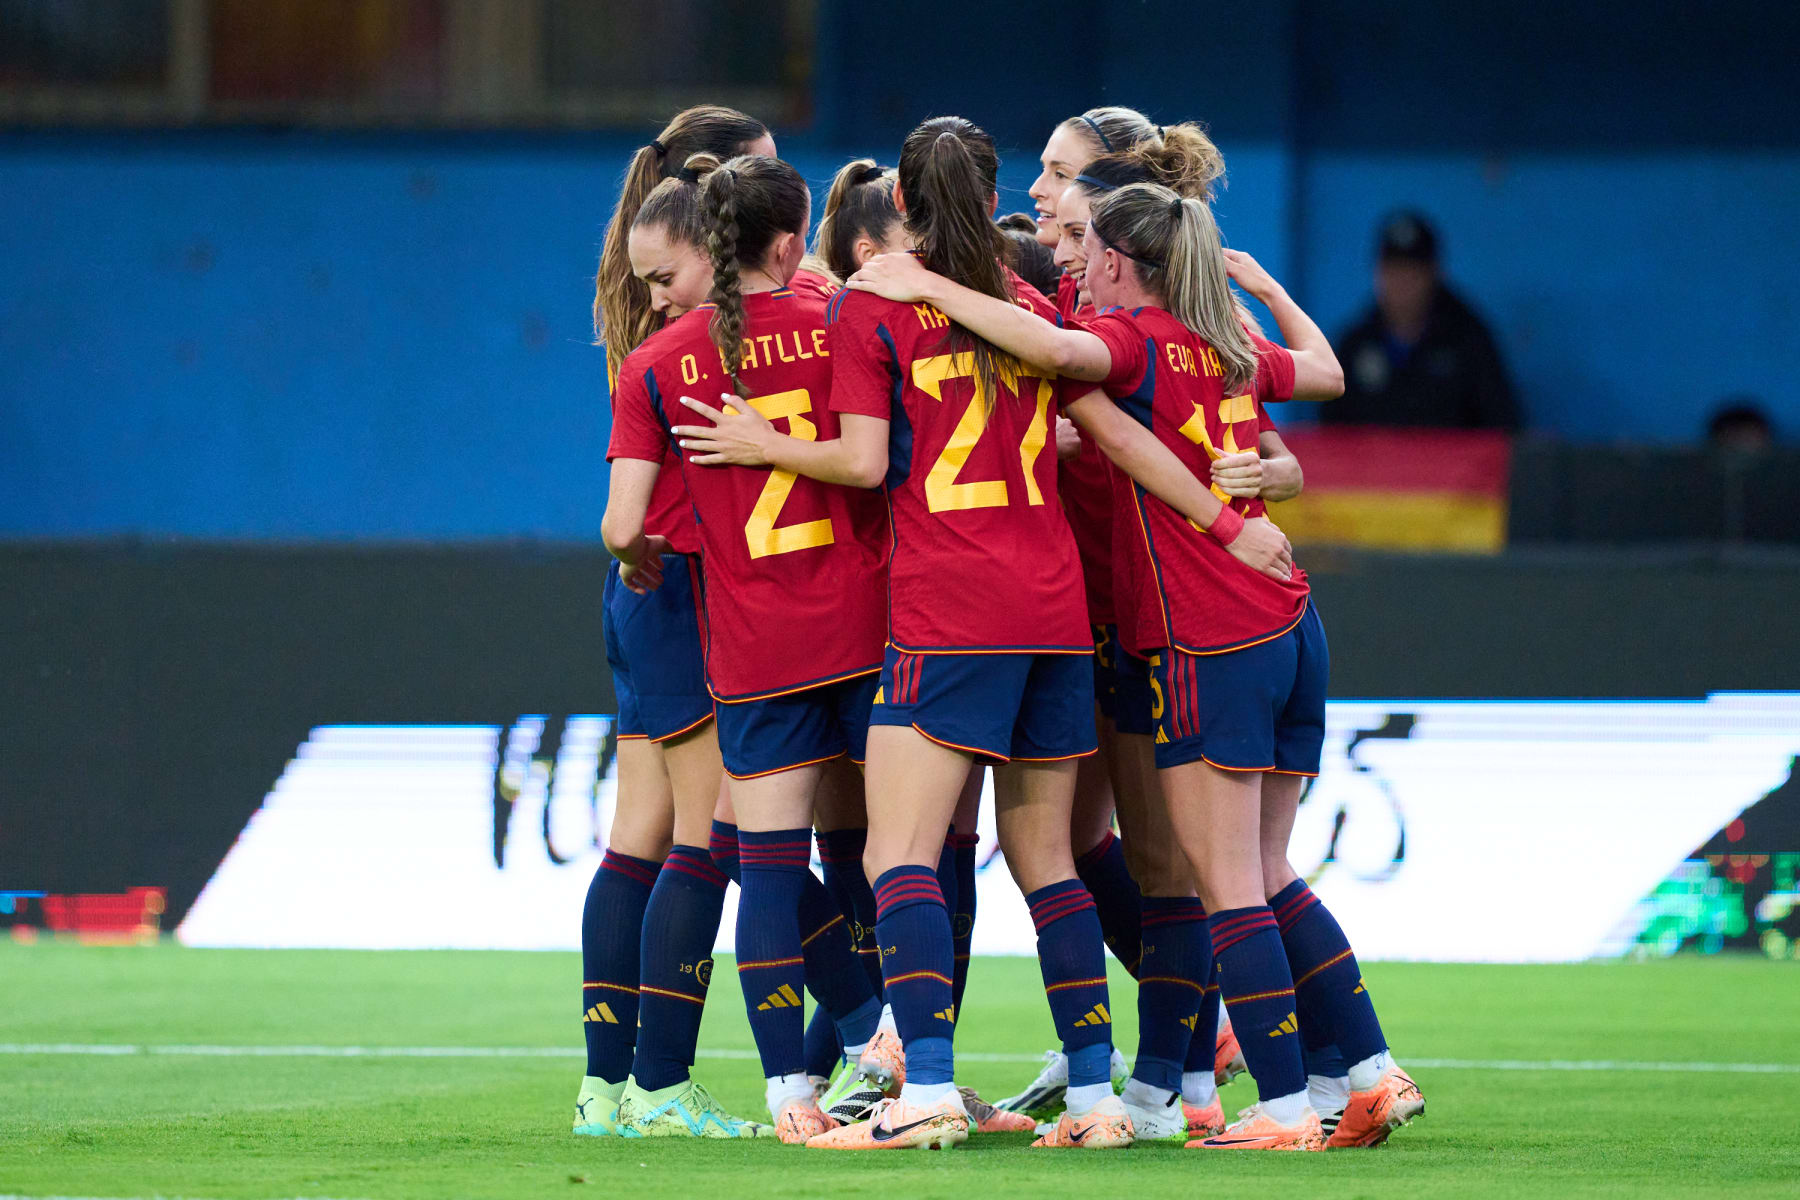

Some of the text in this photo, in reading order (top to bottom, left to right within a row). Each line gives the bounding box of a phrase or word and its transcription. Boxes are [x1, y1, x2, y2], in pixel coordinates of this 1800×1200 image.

[680, 353, 709, 386] O.
[1166, 342, 1226, 377] EVA NA
[722, 388, 835, 560] 2
[911, 350, 1058, 513] 27
